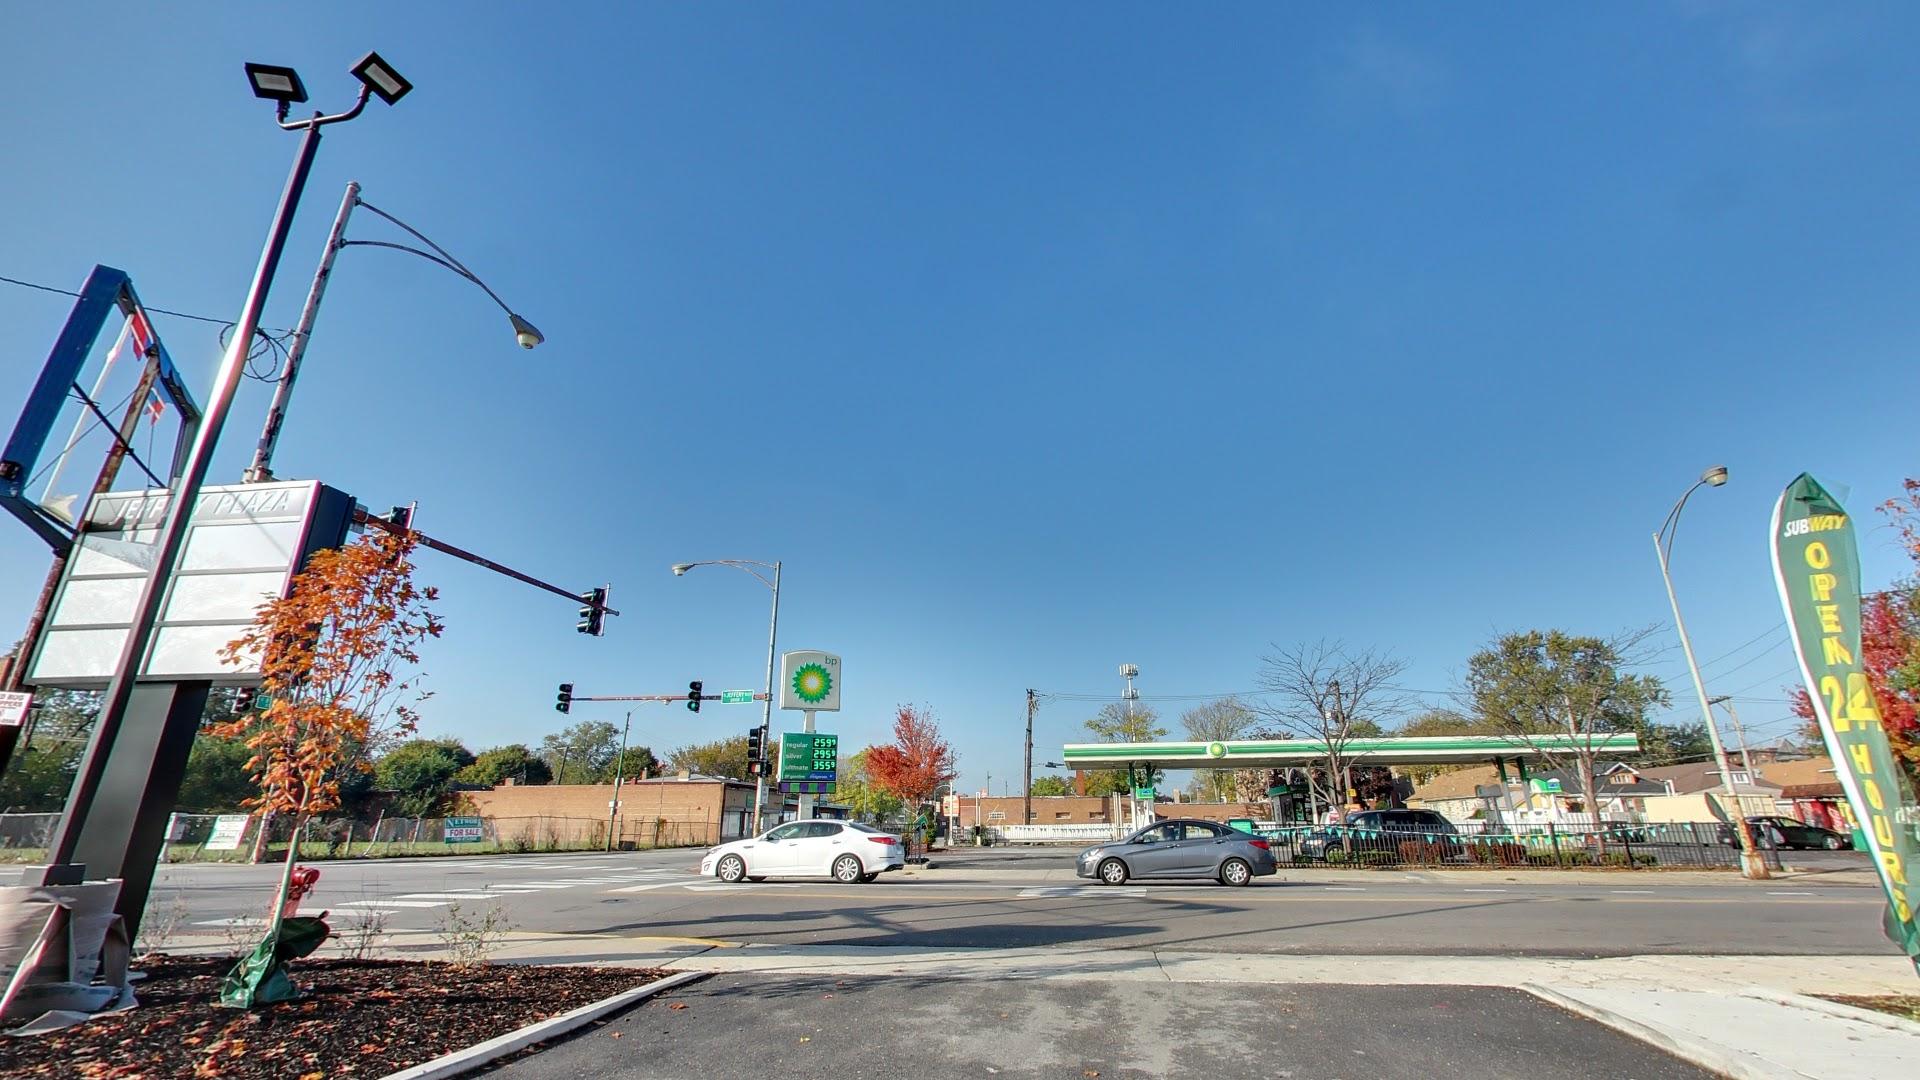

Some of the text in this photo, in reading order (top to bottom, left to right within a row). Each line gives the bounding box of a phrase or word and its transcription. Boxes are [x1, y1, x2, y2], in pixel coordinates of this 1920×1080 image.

[213, 490, 289, 514] PLAZA
[1784, 514, 1846, 537] SUBWAY
[825, 655, 837, 667] bp
[1804, 541, 1912, 923] OPEN 24 HOURS
